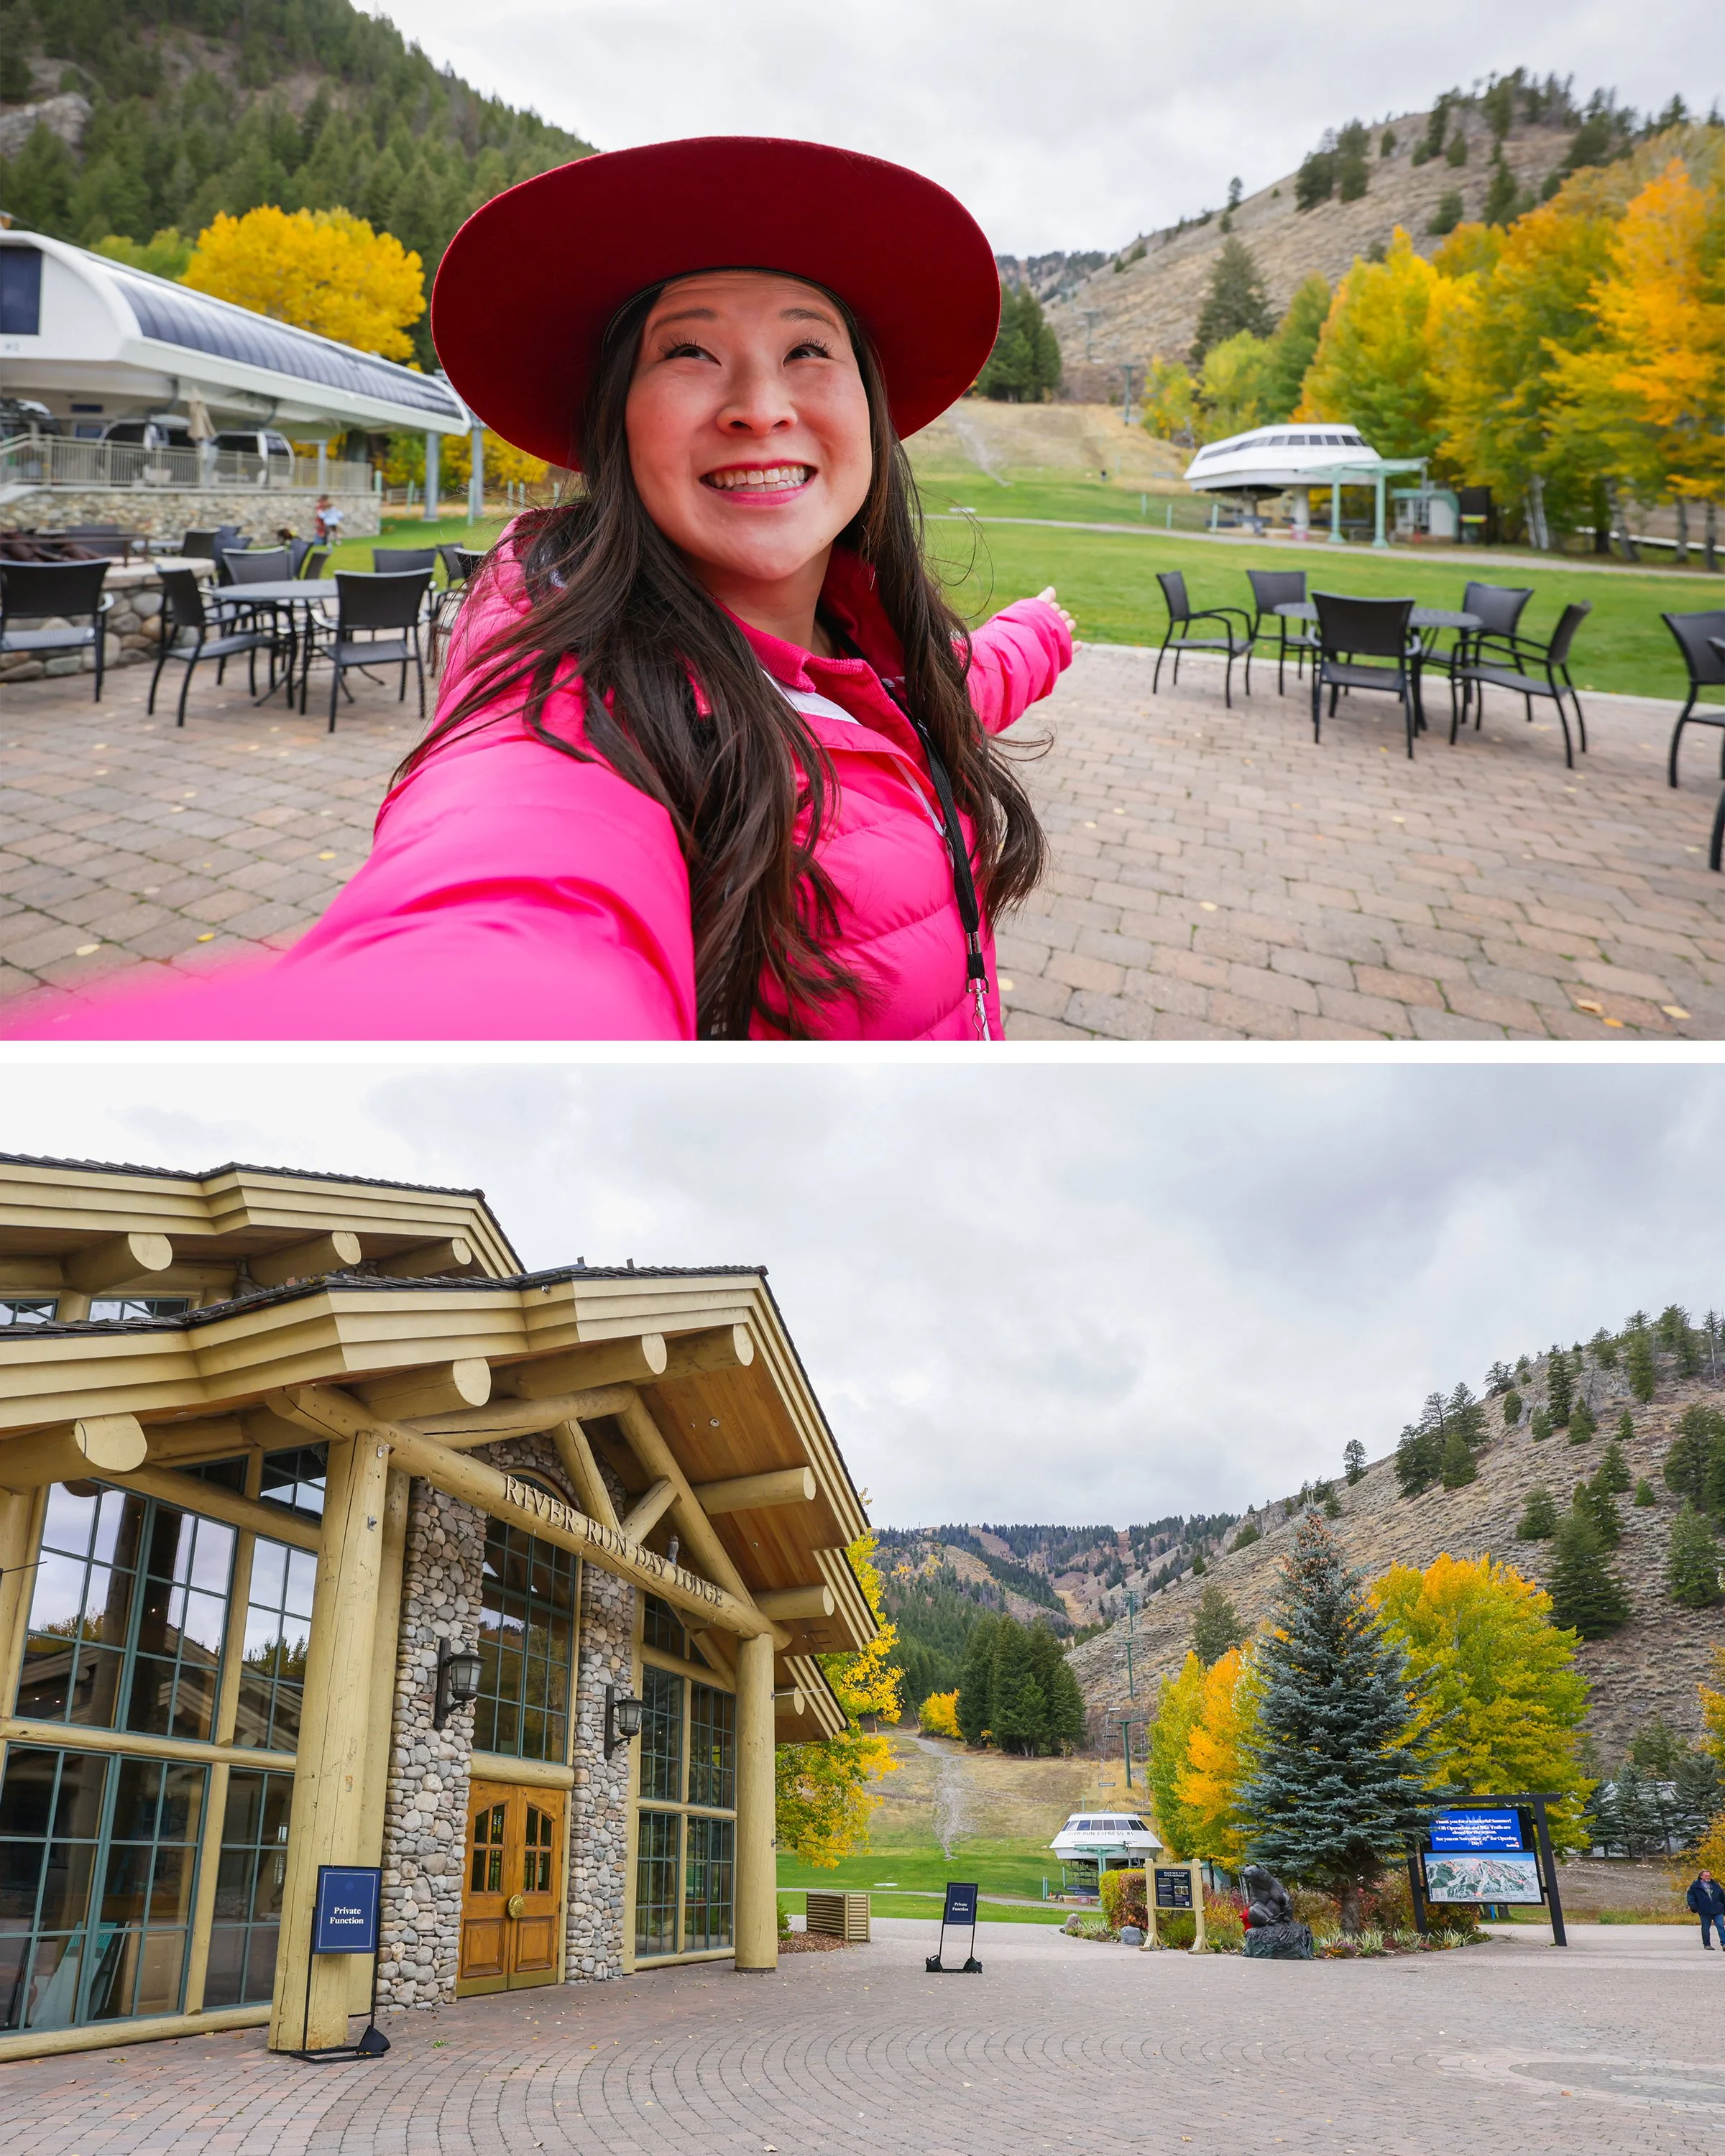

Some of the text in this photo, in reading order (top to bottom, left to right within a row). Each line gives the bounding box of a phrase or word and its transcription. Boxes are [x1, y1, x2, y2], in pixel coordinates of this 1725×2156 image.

[505, 1474, 724, 1608] RIVER RUN DAY LODGE
